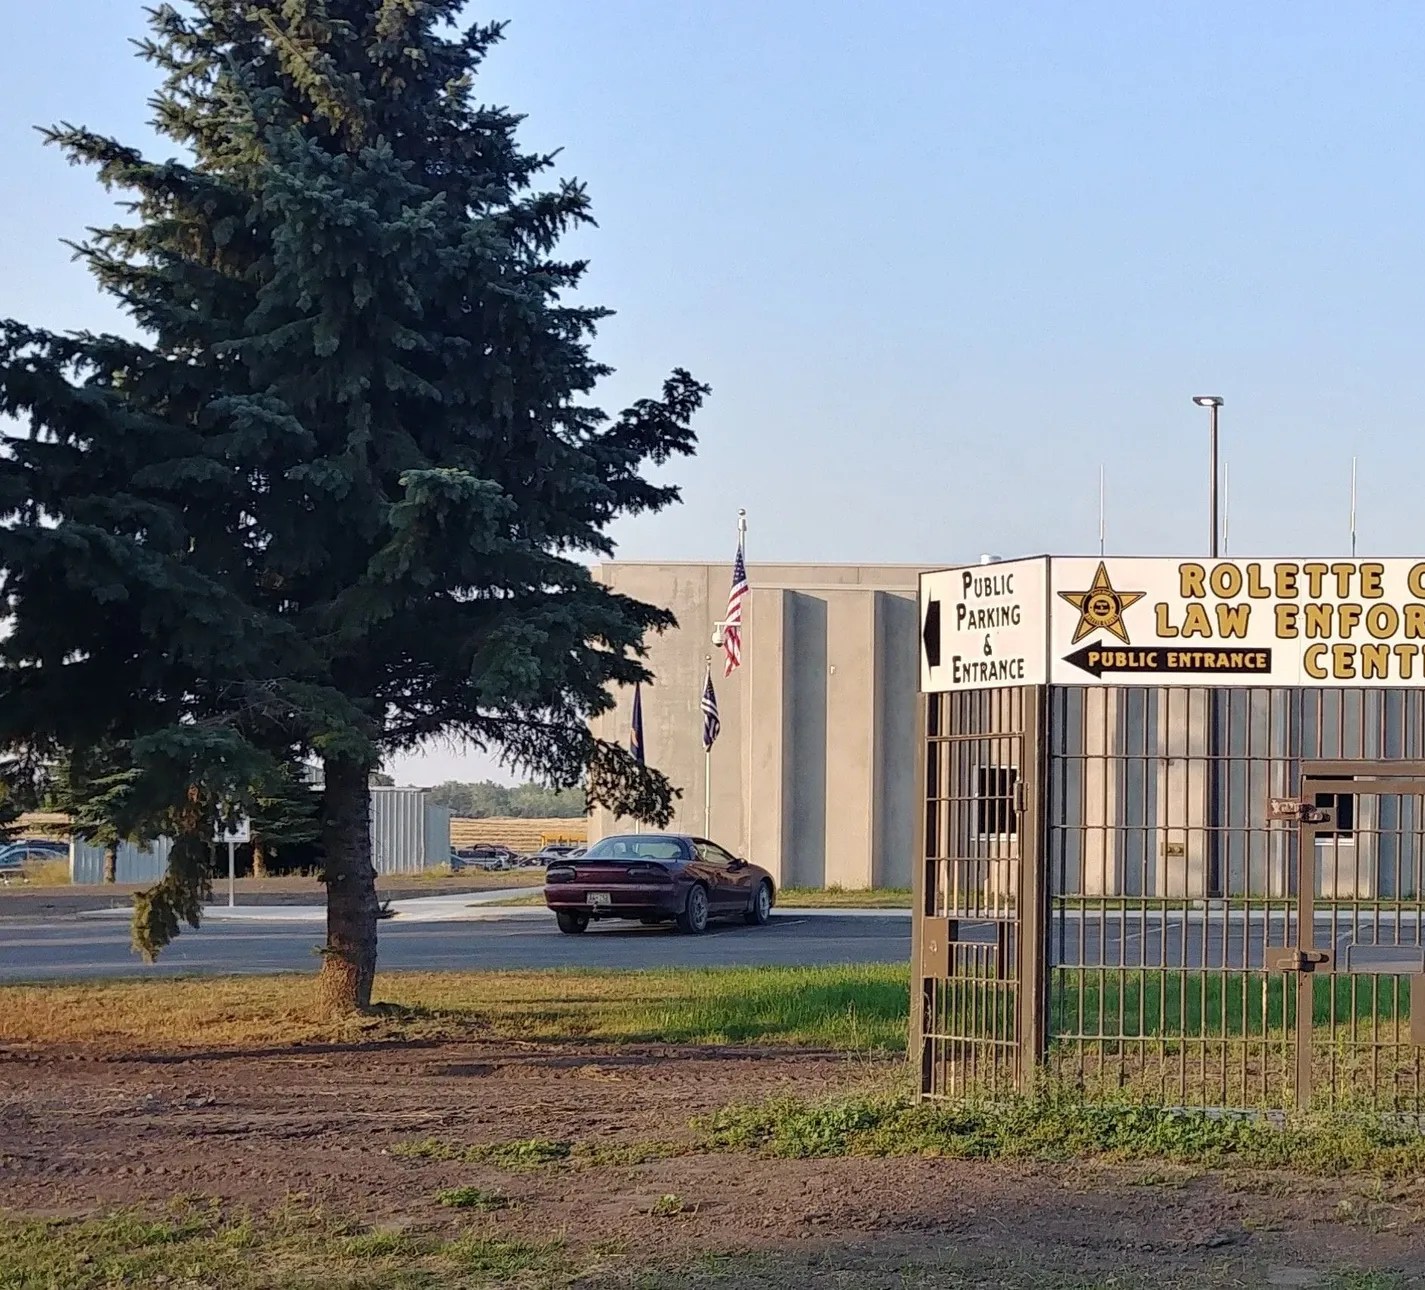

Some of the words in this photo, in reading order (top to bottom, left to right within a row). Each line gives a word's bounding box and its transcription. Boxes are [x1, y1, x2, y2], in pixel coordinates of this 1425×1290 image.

[962, 571, 1014, 600] PUBLIC
[1179, 562, 1385, 599] ROLETTE
[956, 602, 1021, 632] PARKING
[1154, 602, 1251, 639] LAW
[983, 633, 993, 656] &
[952, 656, 1025, 684] ENTRANCE
[1088, 651, 1158, 668] PUBLIC
[1167, 652, 1268, 669] ENTRANCE
